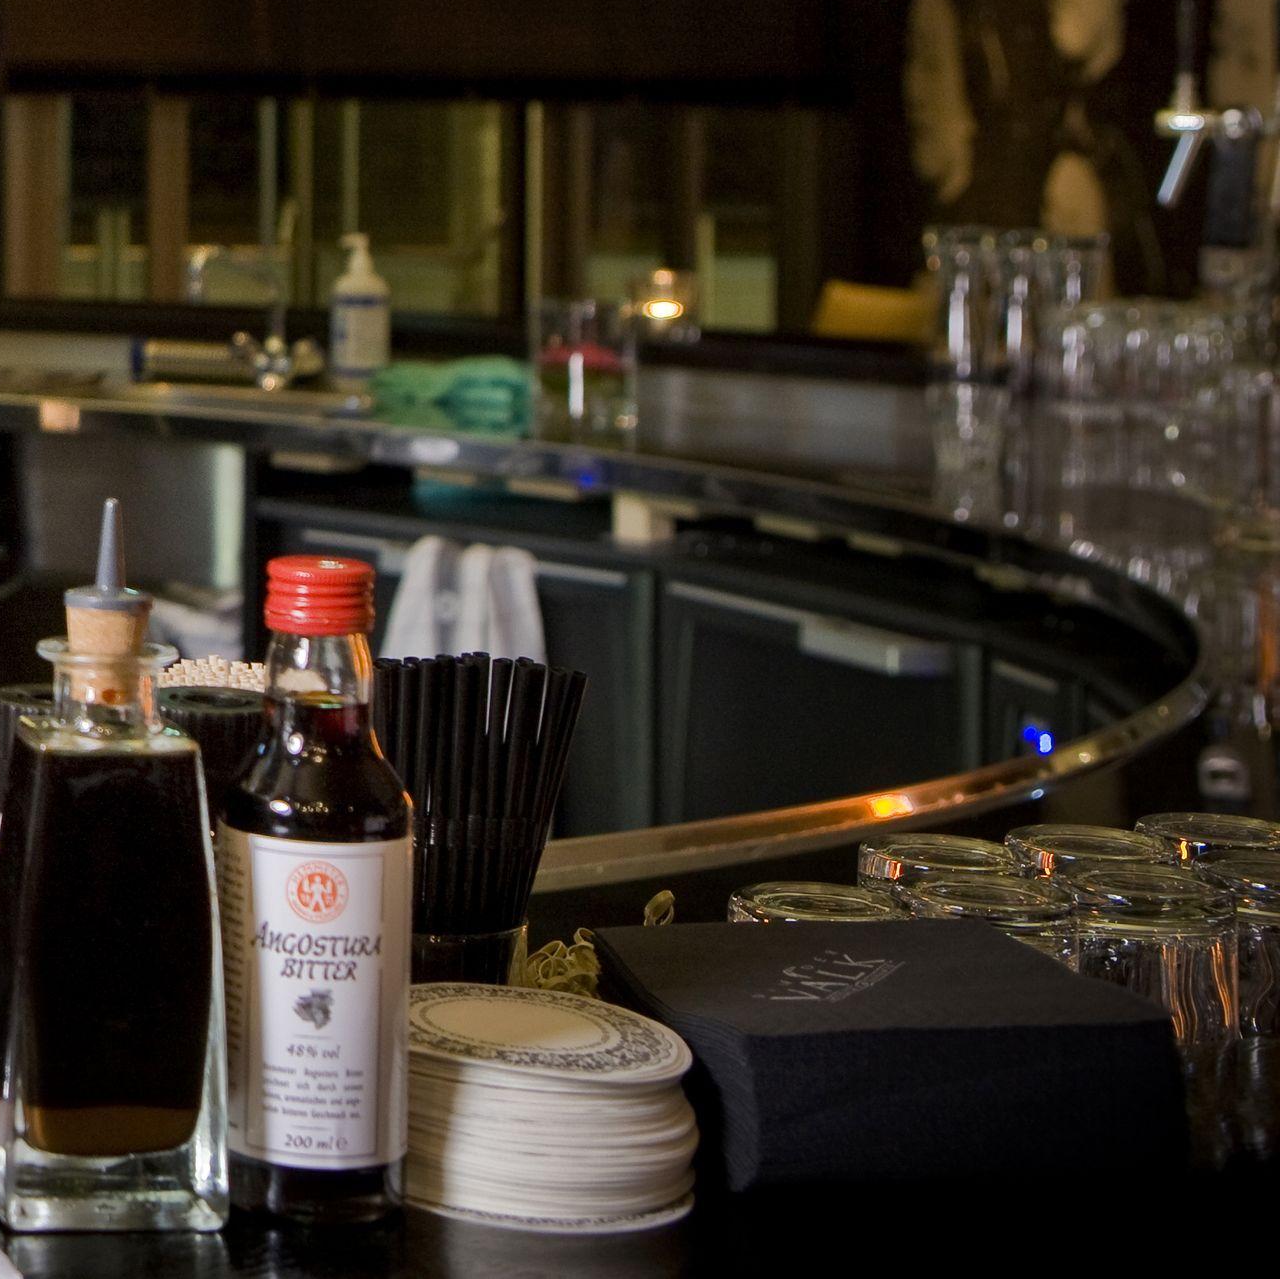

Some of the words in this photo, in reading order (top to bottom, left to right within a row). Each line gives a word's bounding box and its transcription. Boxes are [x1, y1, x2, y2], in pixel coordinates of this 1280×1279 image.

[252, 921, 382, 958] ANGOSTURA
[280, 958, 358, 981] BITTER
[769, 953, 886, 1001] VALK
[286, 1044, 318, 1059] 48%
[322, 1045, 341, 1059] vol
[285, 1133, 313, 1149] 200
[316, 1136, 333, 1150] ml
